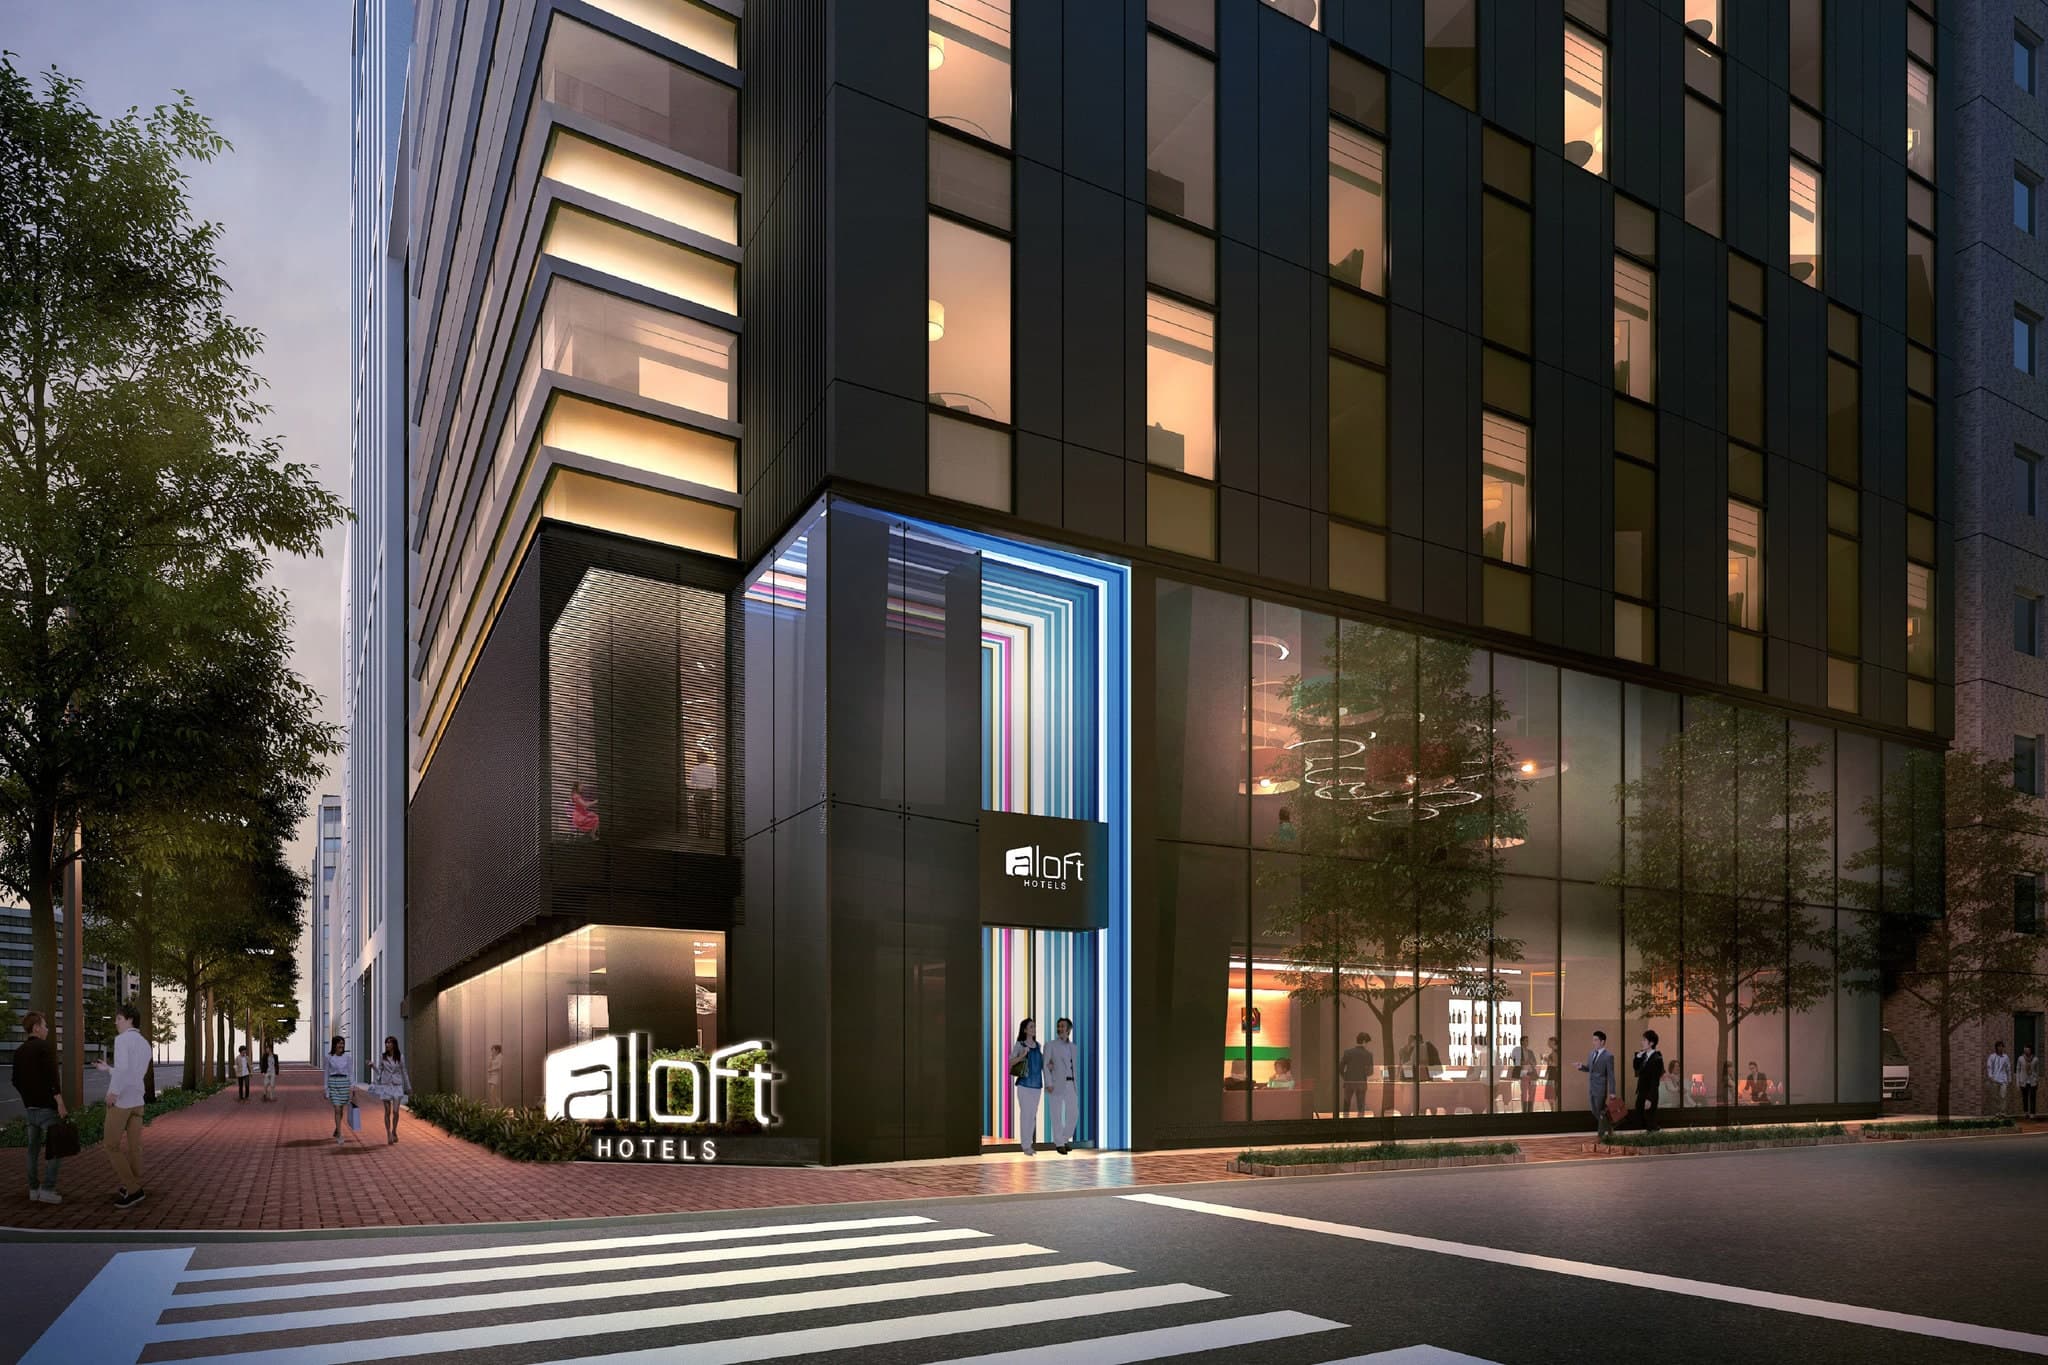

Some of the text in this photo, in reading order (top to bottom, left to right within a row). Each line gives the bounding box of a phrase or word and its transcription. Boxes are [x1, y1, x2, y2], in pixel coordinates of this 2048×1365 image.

[1005, 844, 1085, 881] aloft
[1023, 880, 1067, 891] HOTELS
[544, 1032, 783, 1125] aloft
[597, 1138, 717, 1161] HOTELS
